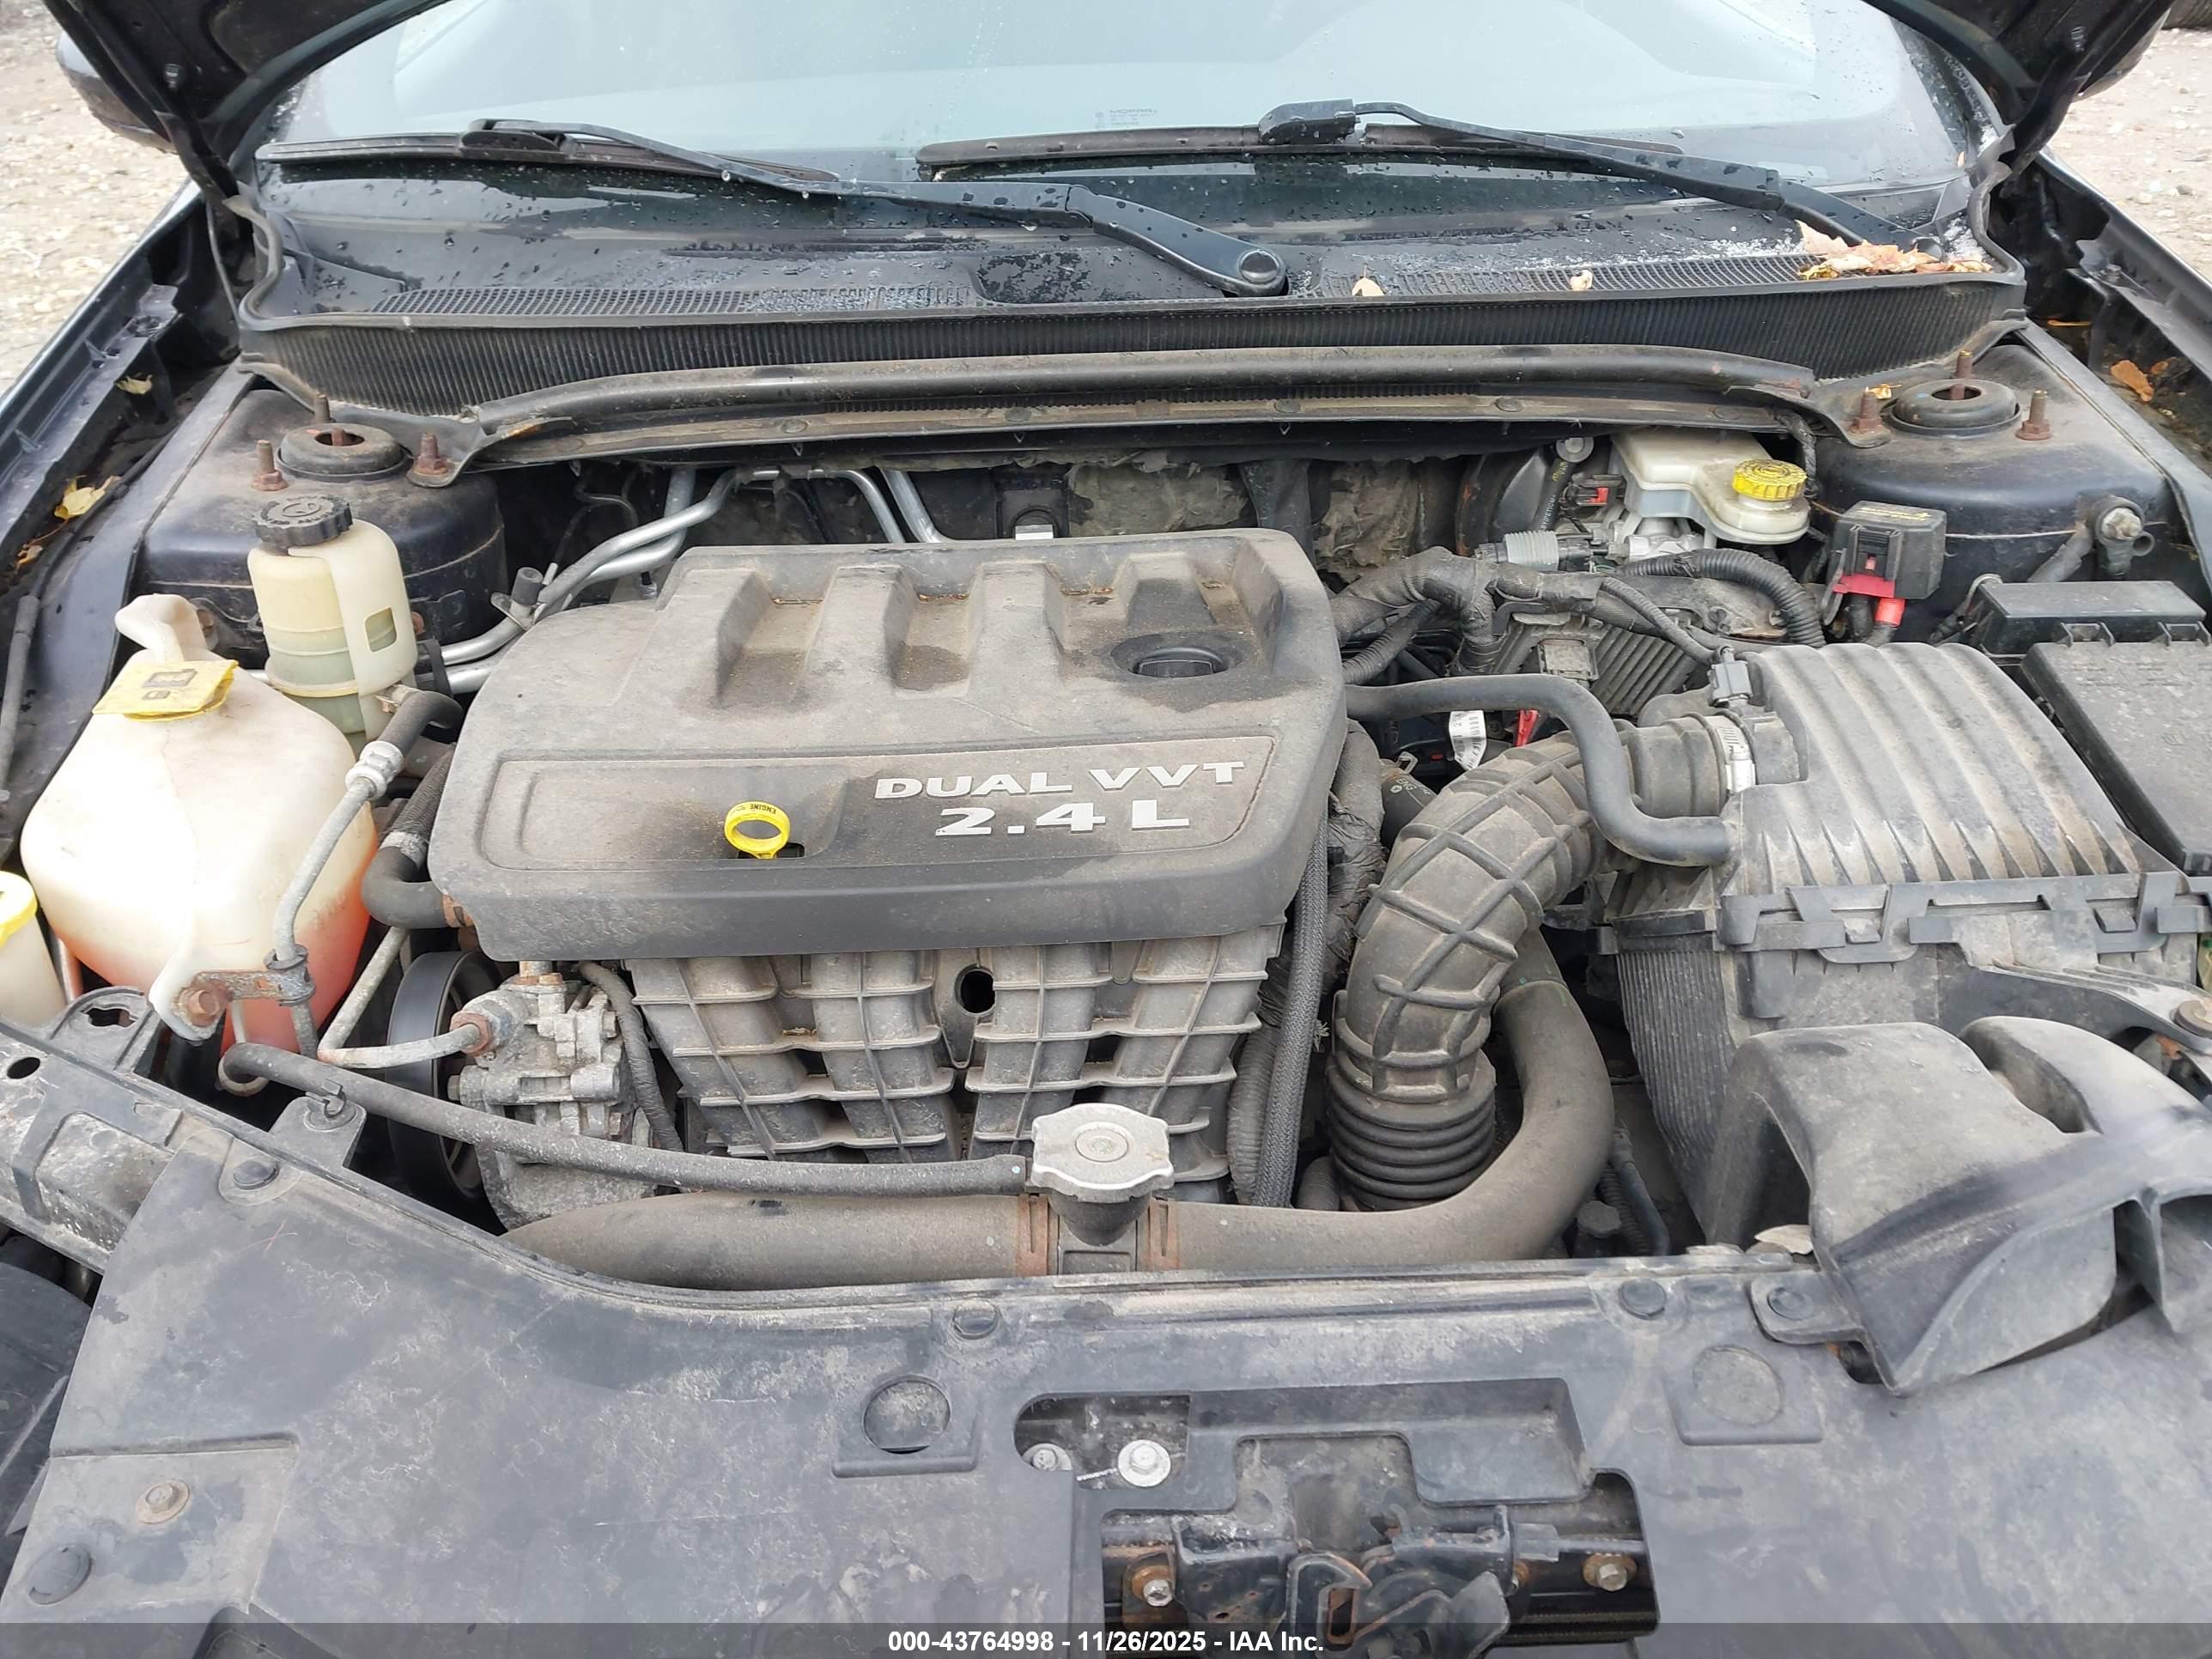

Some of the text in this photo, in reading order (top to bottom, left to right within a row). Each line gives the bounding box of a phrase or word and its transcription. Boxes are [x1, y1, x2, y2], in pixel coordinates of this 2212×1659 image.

[874, 761, 1244, 799] DUAL VVT
[749, 803, 777, 815] ENGINE
